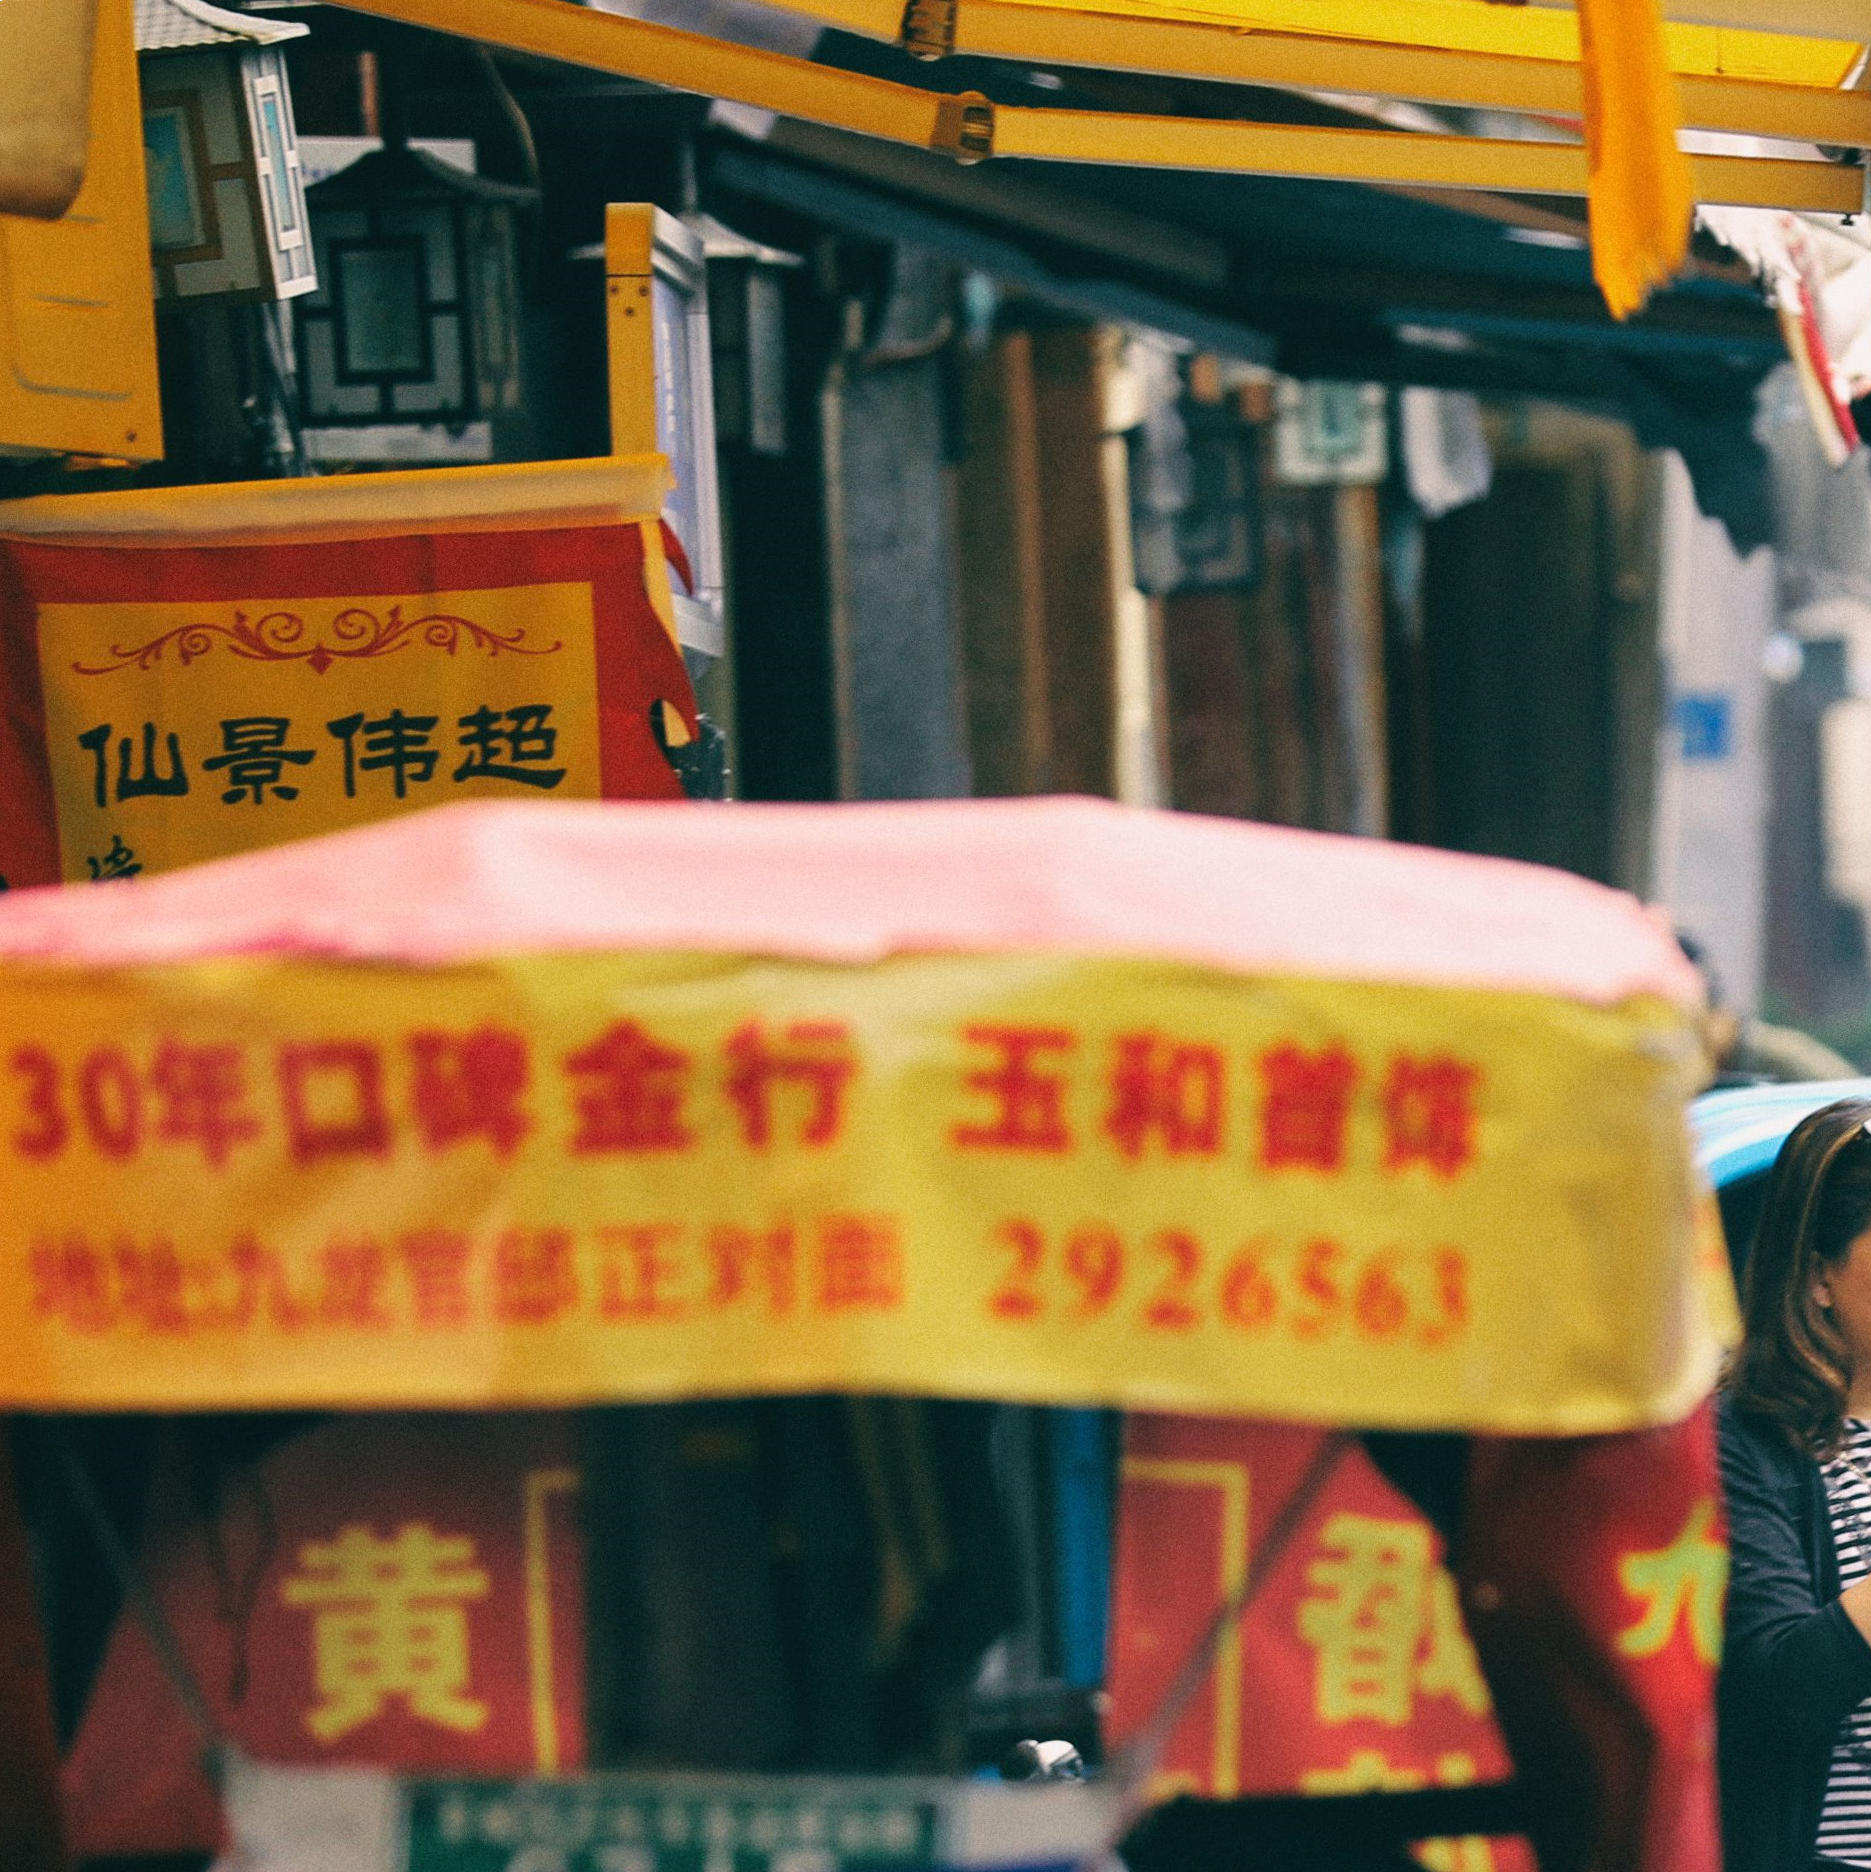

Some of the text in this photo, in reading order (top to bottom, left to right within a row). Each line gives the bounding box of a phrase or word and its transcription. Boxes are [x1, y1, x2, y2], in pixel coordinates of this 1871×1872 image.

[79, 704, 567, 808] 仙景伟超
[988, 1216, 1474, 1350] 2926563
[280, 1518, 490, 1744] 黄
